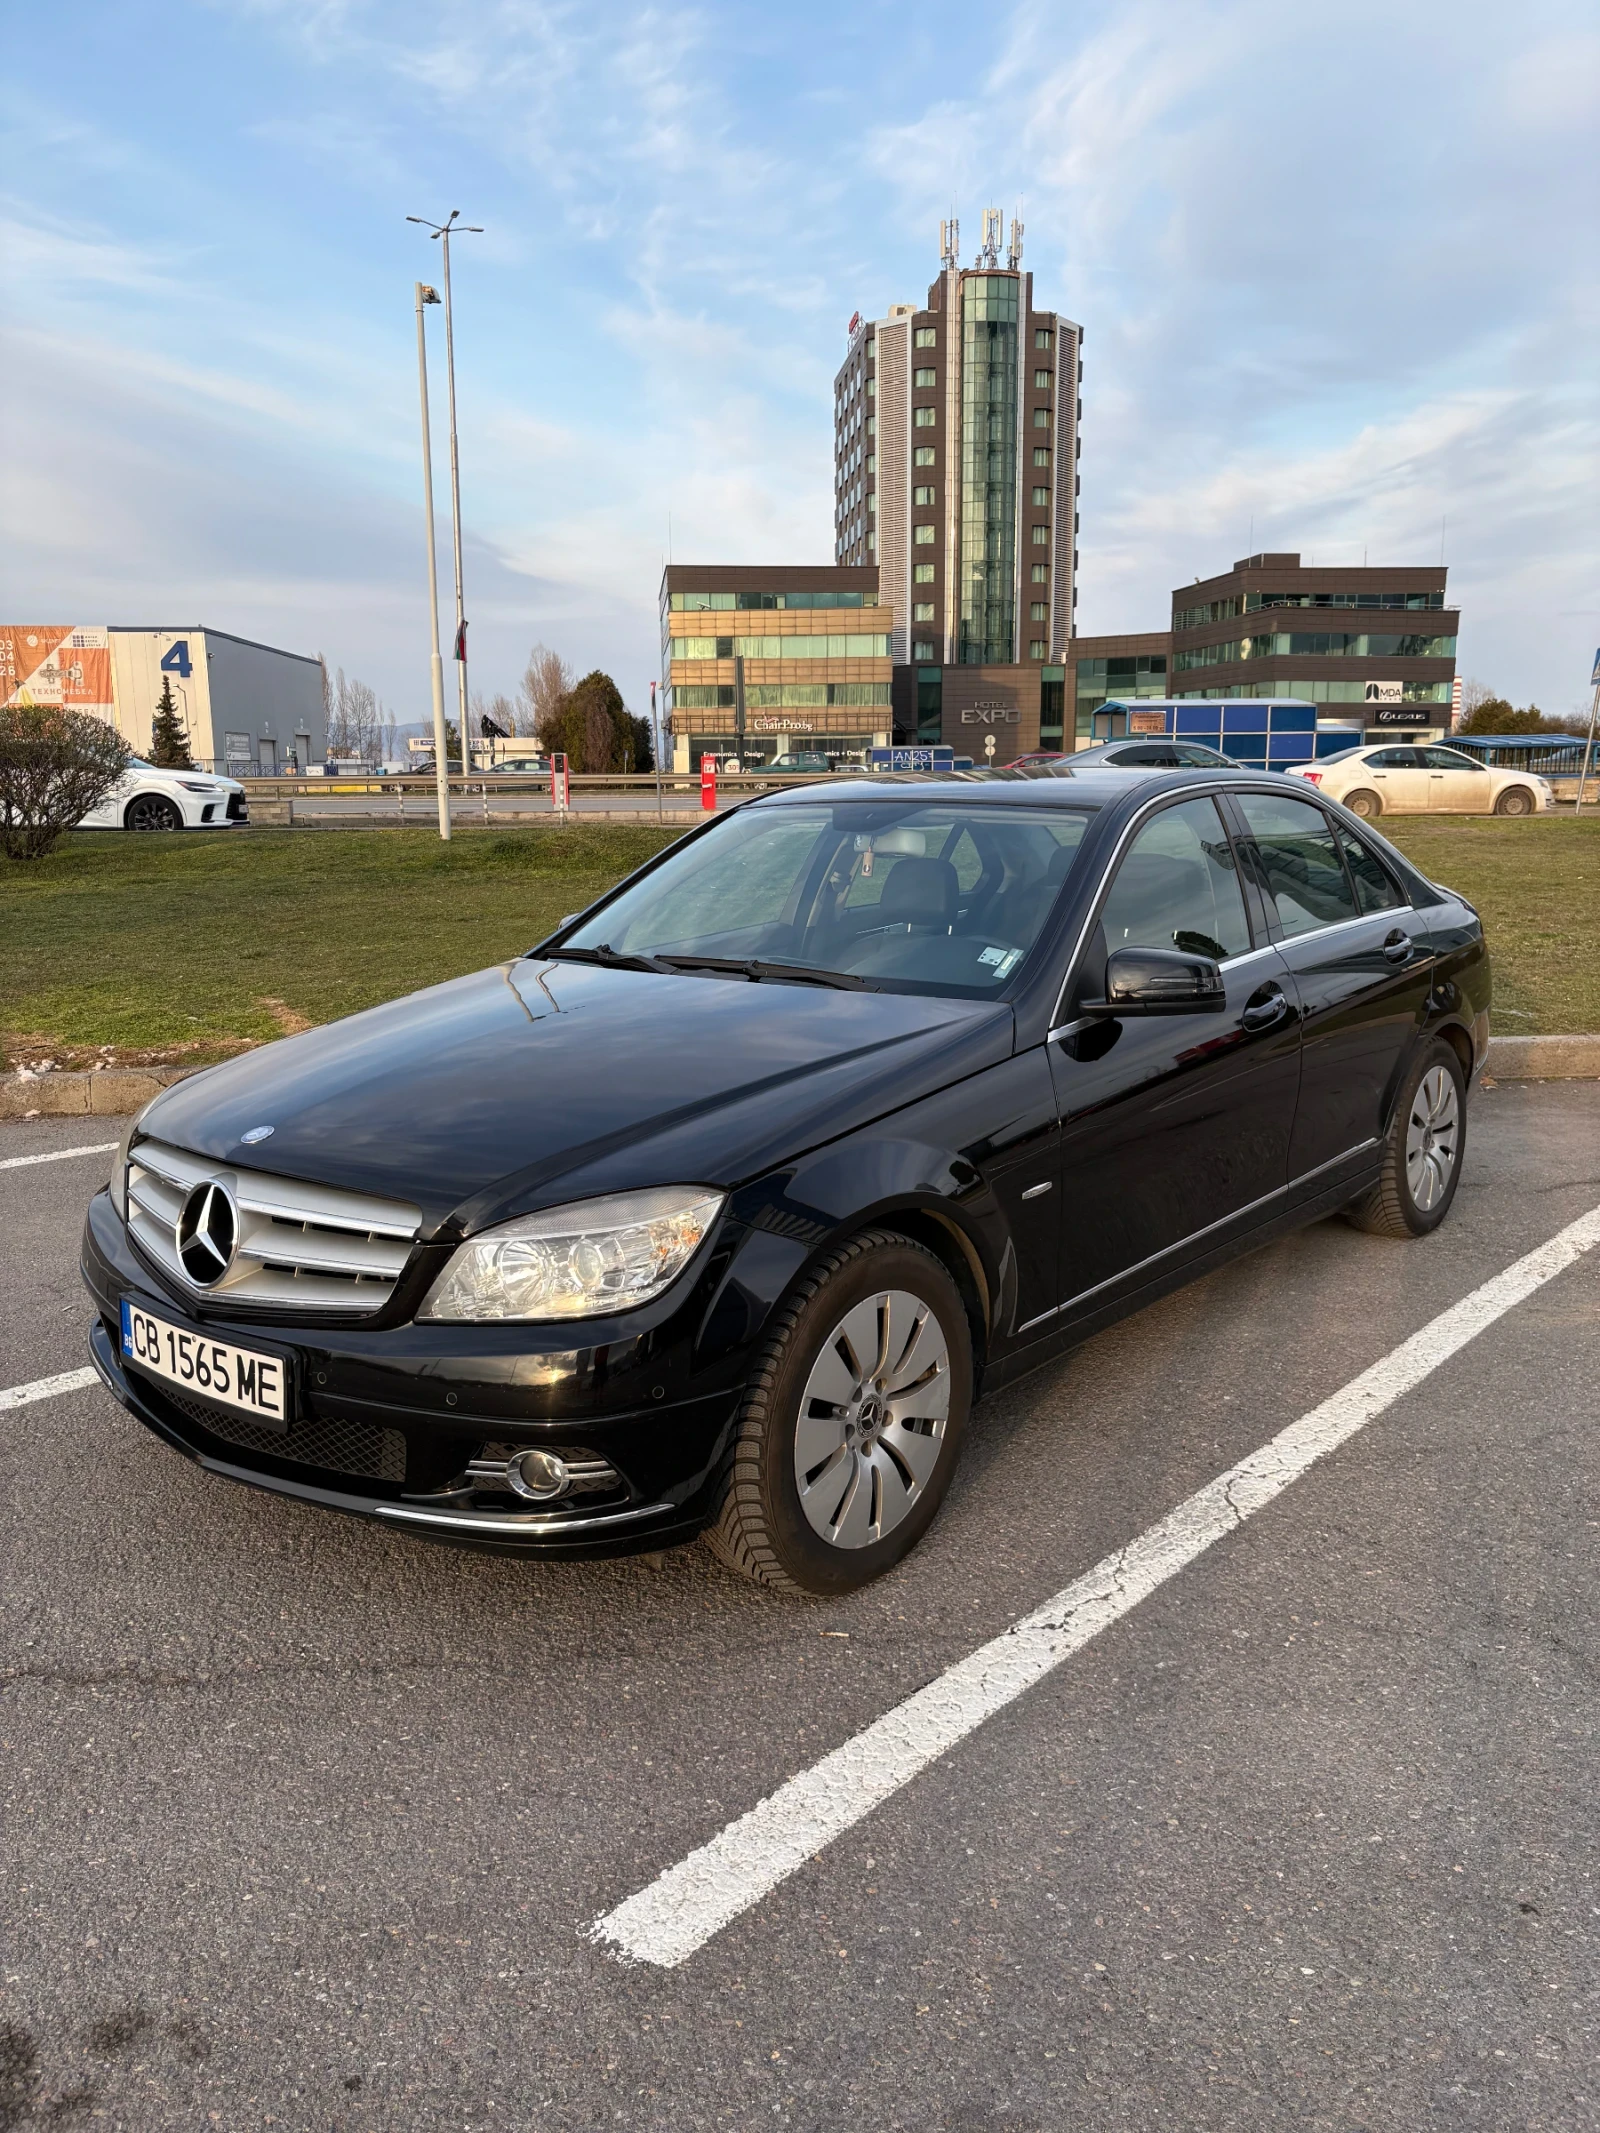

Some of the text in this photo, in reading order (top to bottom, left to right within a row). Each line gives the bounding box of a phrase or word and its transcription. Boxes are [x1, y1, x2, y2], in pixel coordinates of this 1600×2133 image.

[160, 640, 193, 678] 4
[1380, 688, 1401, 697] MDA
[974, 701, 1008, 709] HOTEL
[961, 709, 1021, 724] EXPO
[124, 1333, 133, 1349] BG
[133, 1313, 280, 1412] CB 1565 ME
